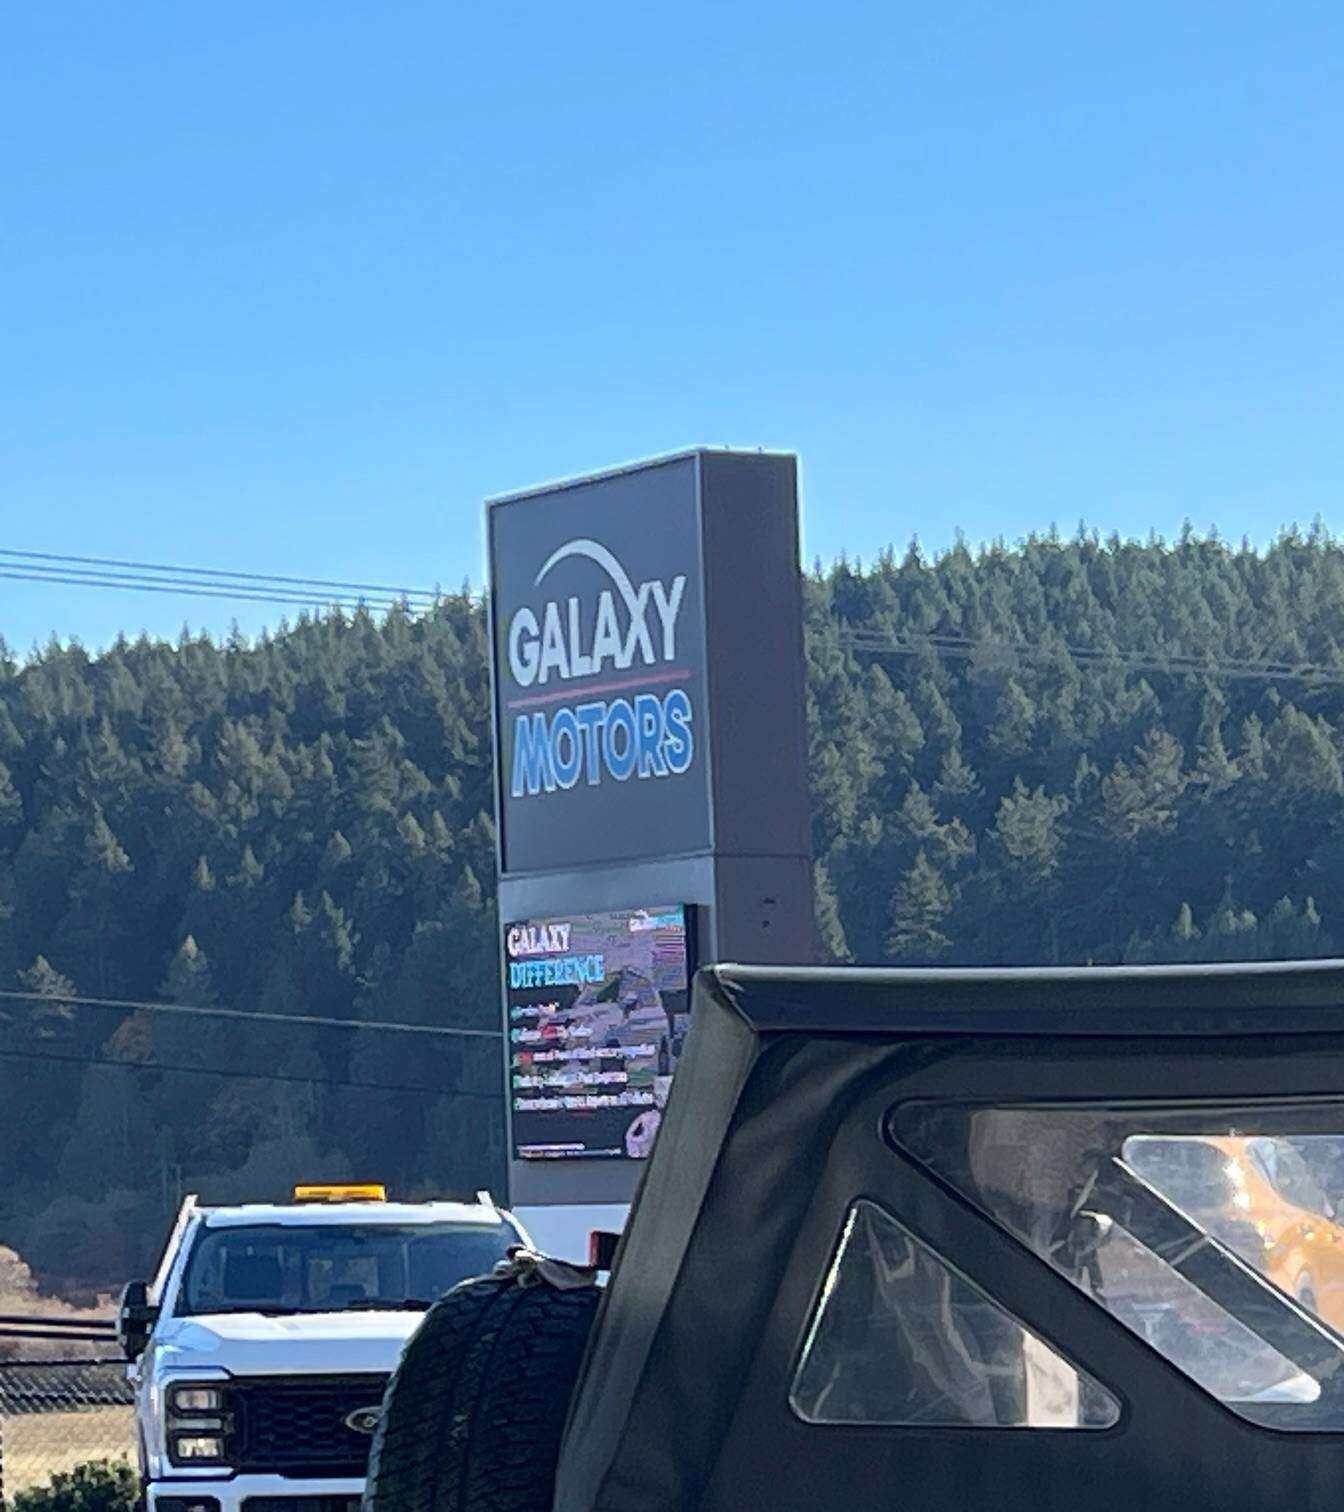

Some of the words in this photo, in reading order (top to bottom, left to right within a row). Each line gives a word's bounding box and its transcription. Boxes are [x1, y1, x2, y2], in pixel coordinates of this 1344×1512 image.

[509, 576, 686, 687] GALAXY
[511, 689, 693, 797] MOTORS
[507, 923, 571, 957] GALAXY
[509, 954, 605, 989] DIFFERENCE
